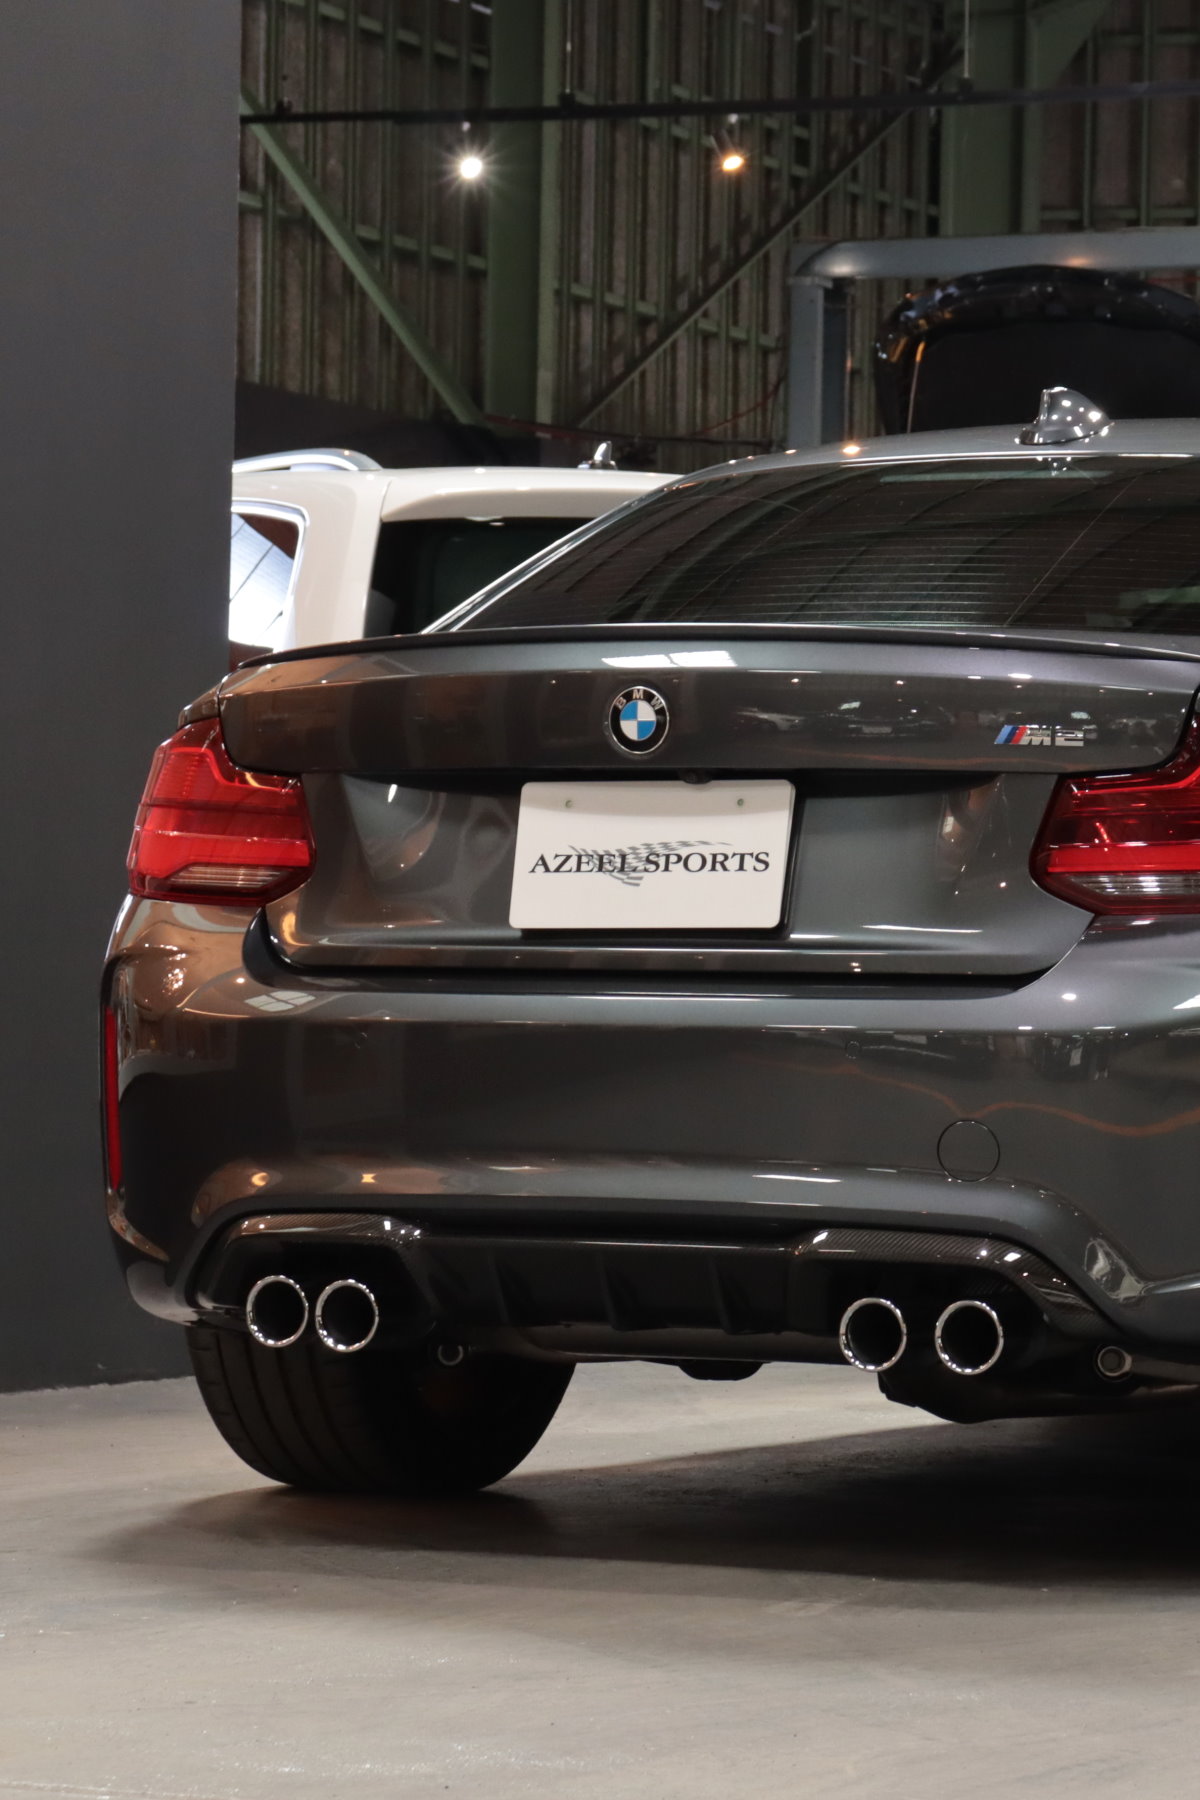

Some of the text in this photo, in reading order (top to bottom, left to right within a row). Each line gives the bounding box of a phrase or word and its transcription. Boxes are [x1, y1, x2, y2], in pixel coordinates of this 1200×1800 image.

[614, 688, 665, 710] BMW
[1017, 724, 1085, 747] M2
[528, 850, 771, 874] AZEEL SPORTS
